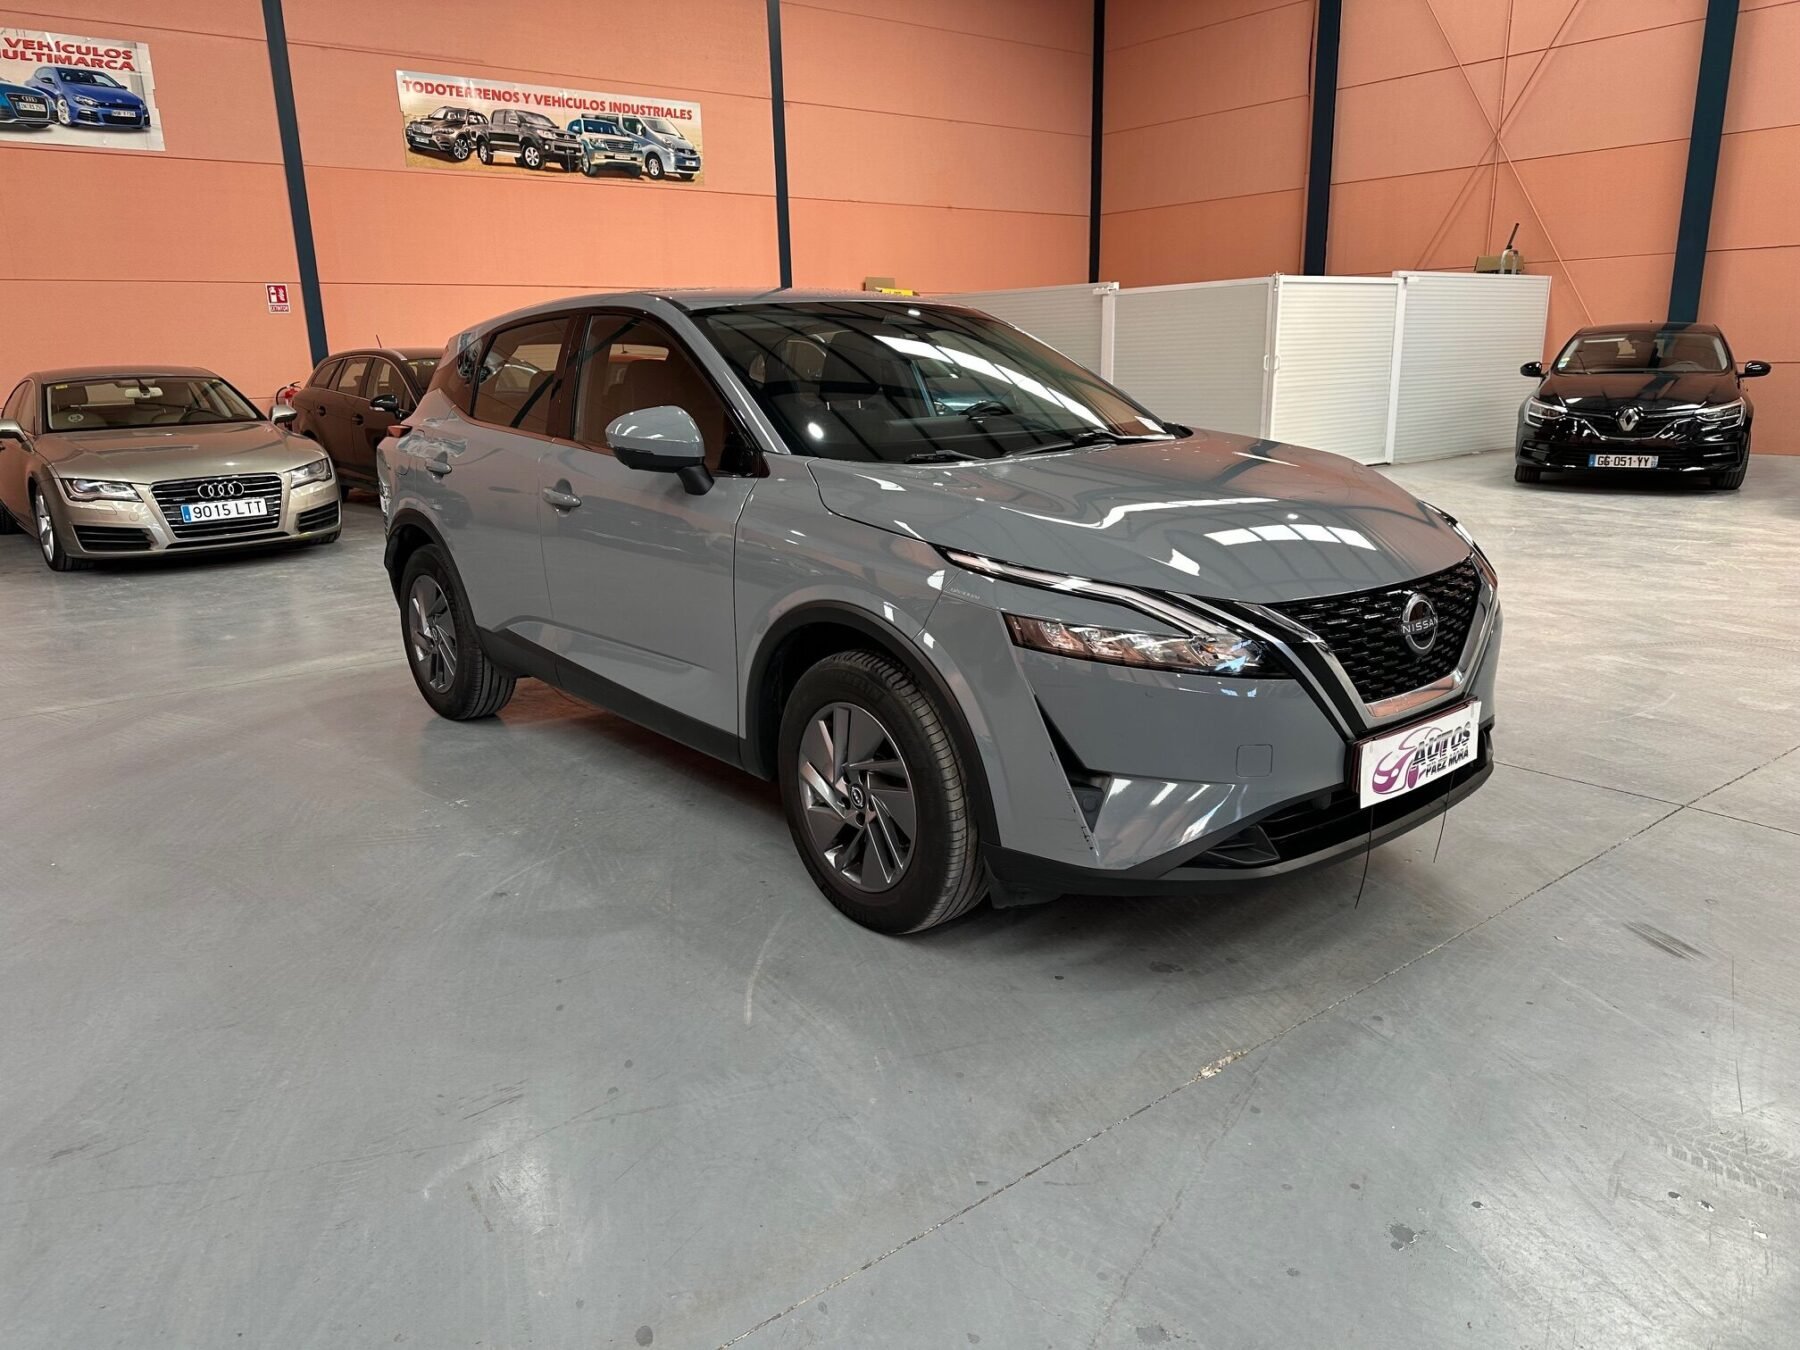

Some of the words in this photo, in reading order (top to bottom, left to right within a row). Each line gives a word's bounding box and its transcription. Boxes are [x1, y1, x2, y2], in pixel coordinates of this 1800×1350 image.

[4, 37, 133, 59] VEHÍCULOS
[0, 49, 136, 71] ULTIMARCA
[402, 80, 520, 103] TODOTERRENOS
[522, 92, 531, 104] Y
[608, 101, 693, 120] INDUSTRIALES
[192, 503, 231, 519] 9015
[235, 500, 262, 515] LTT
[1402, 616, 1438, 634] NISSAN
